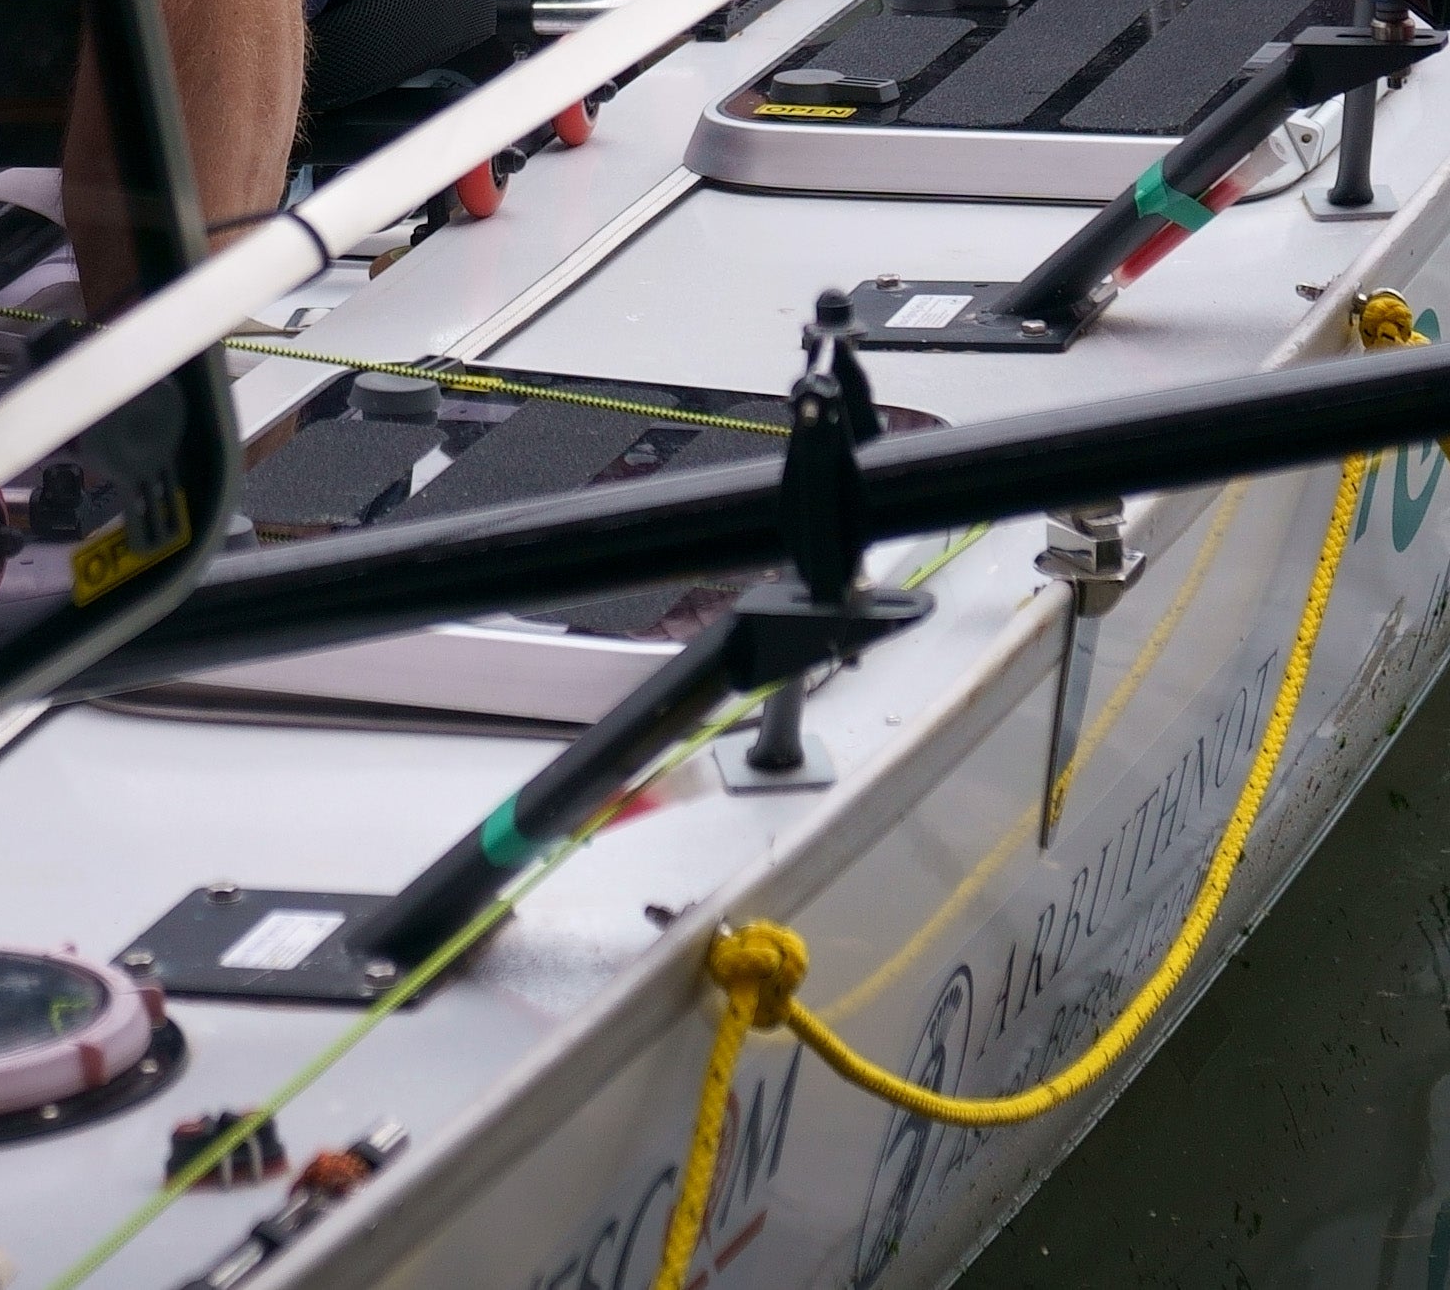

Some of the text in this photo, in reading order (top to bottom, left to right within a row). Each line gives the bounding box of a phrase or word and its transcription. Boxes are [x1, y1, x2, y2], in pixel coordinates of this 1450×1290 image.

[765, 106, 847, 115] OPEN
[976, 649, 1278, 1061] ARBUTHNOT
[1038, 947, 1131, 1083] Based
